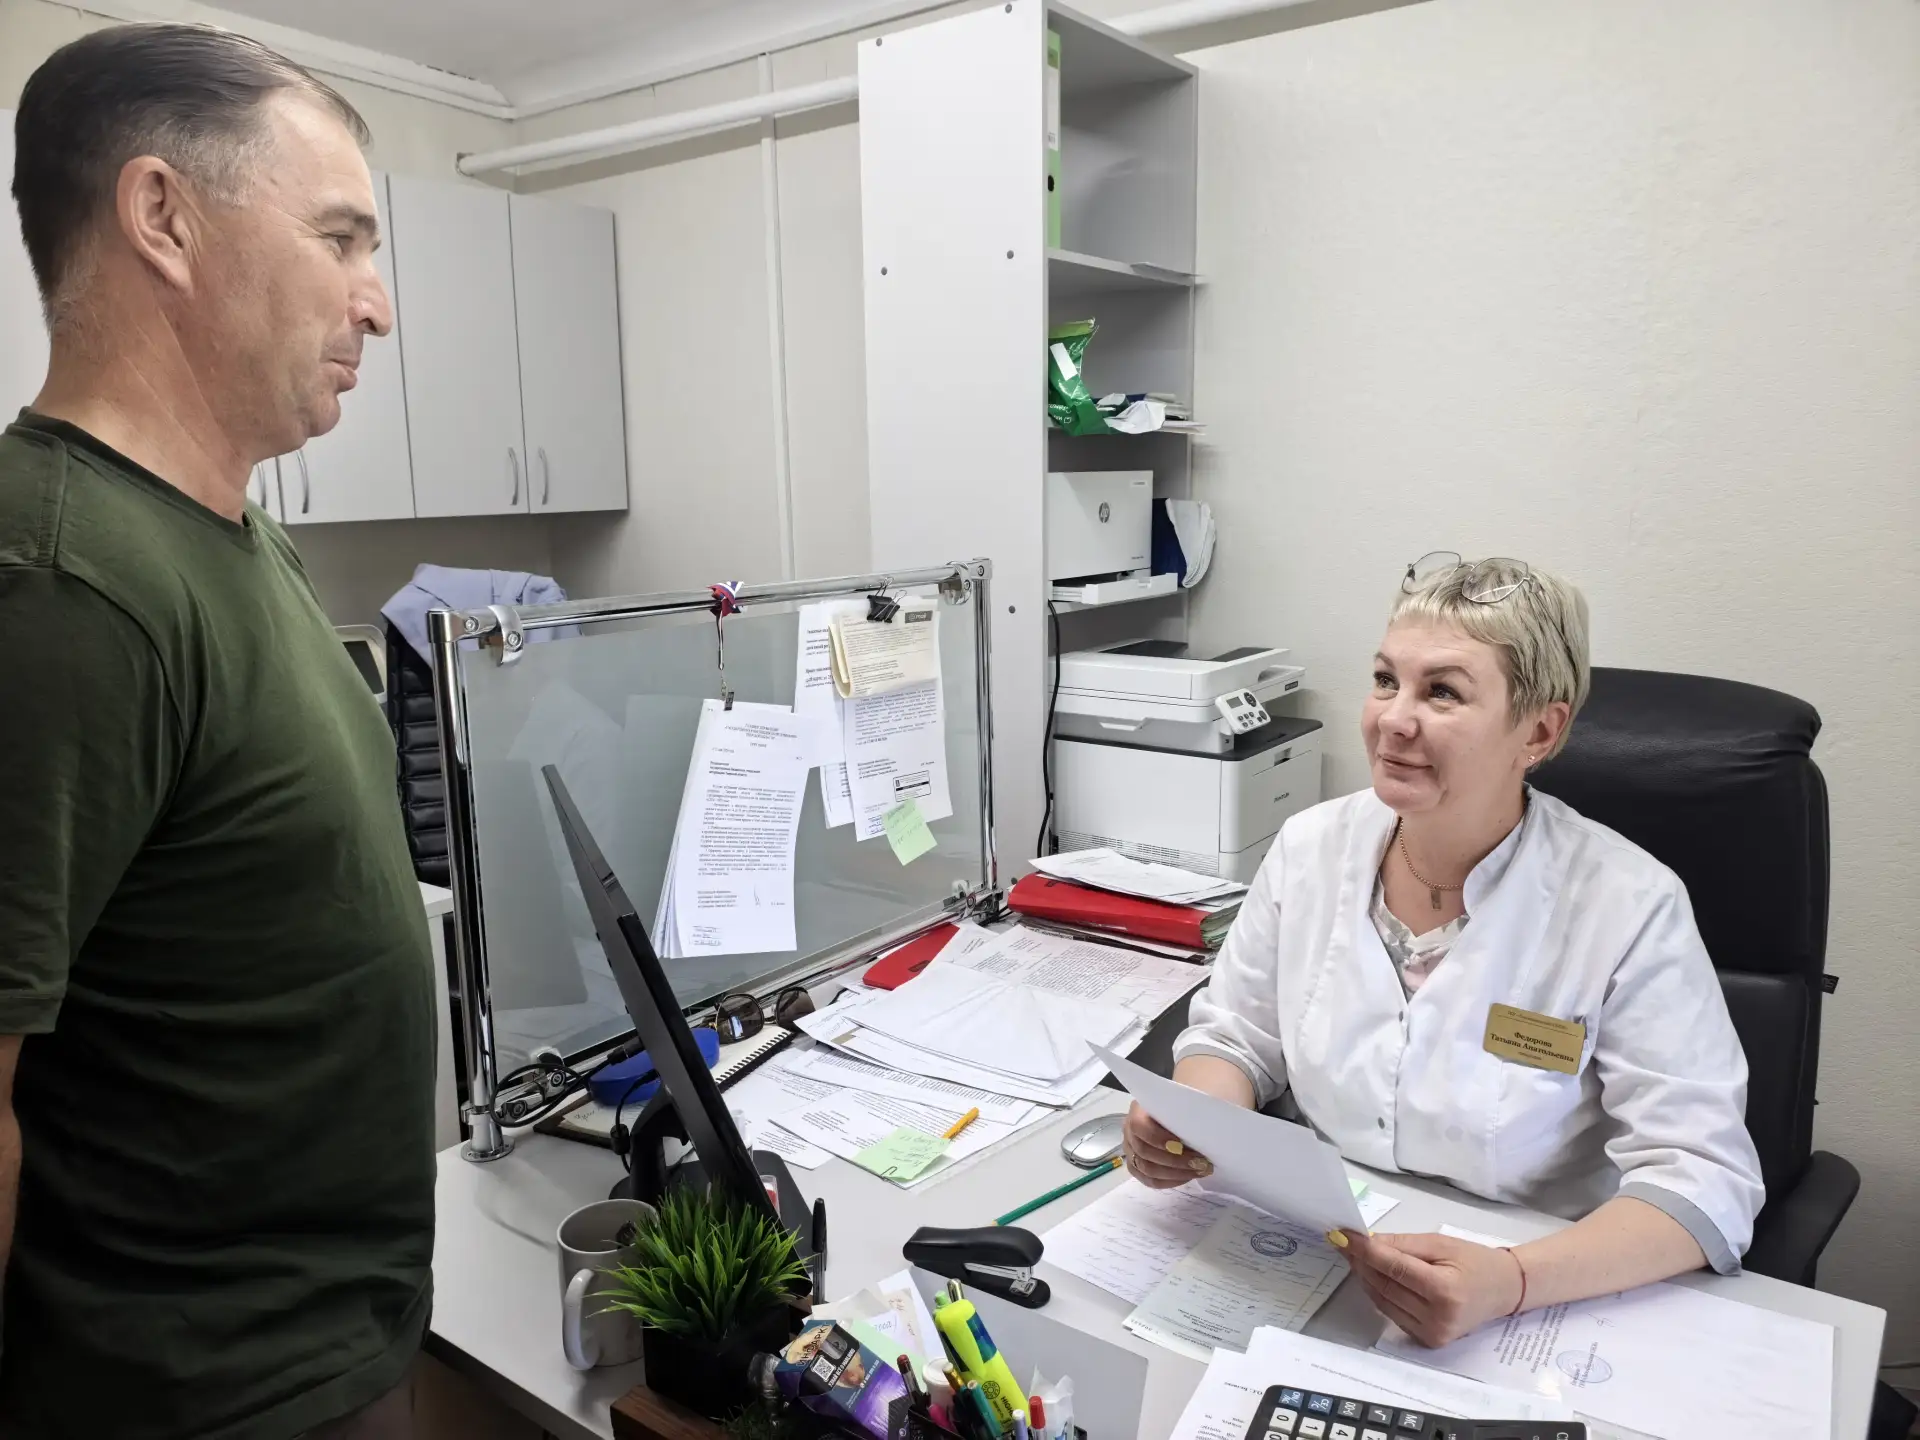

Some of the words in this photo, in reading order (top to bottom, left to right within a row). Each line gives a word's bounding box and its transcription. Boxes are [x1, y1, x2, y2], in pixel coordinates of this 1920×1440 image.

[1490, 1033, 1521, 1048] Татьяна
[1522, 1042, 1574, 1062] Анатольевна
[1514, 1032, 1552, 1048] Федорова
[1403, 1413, 1418, 1428] MC
[1336, 1429, 1349, 1437] 4
